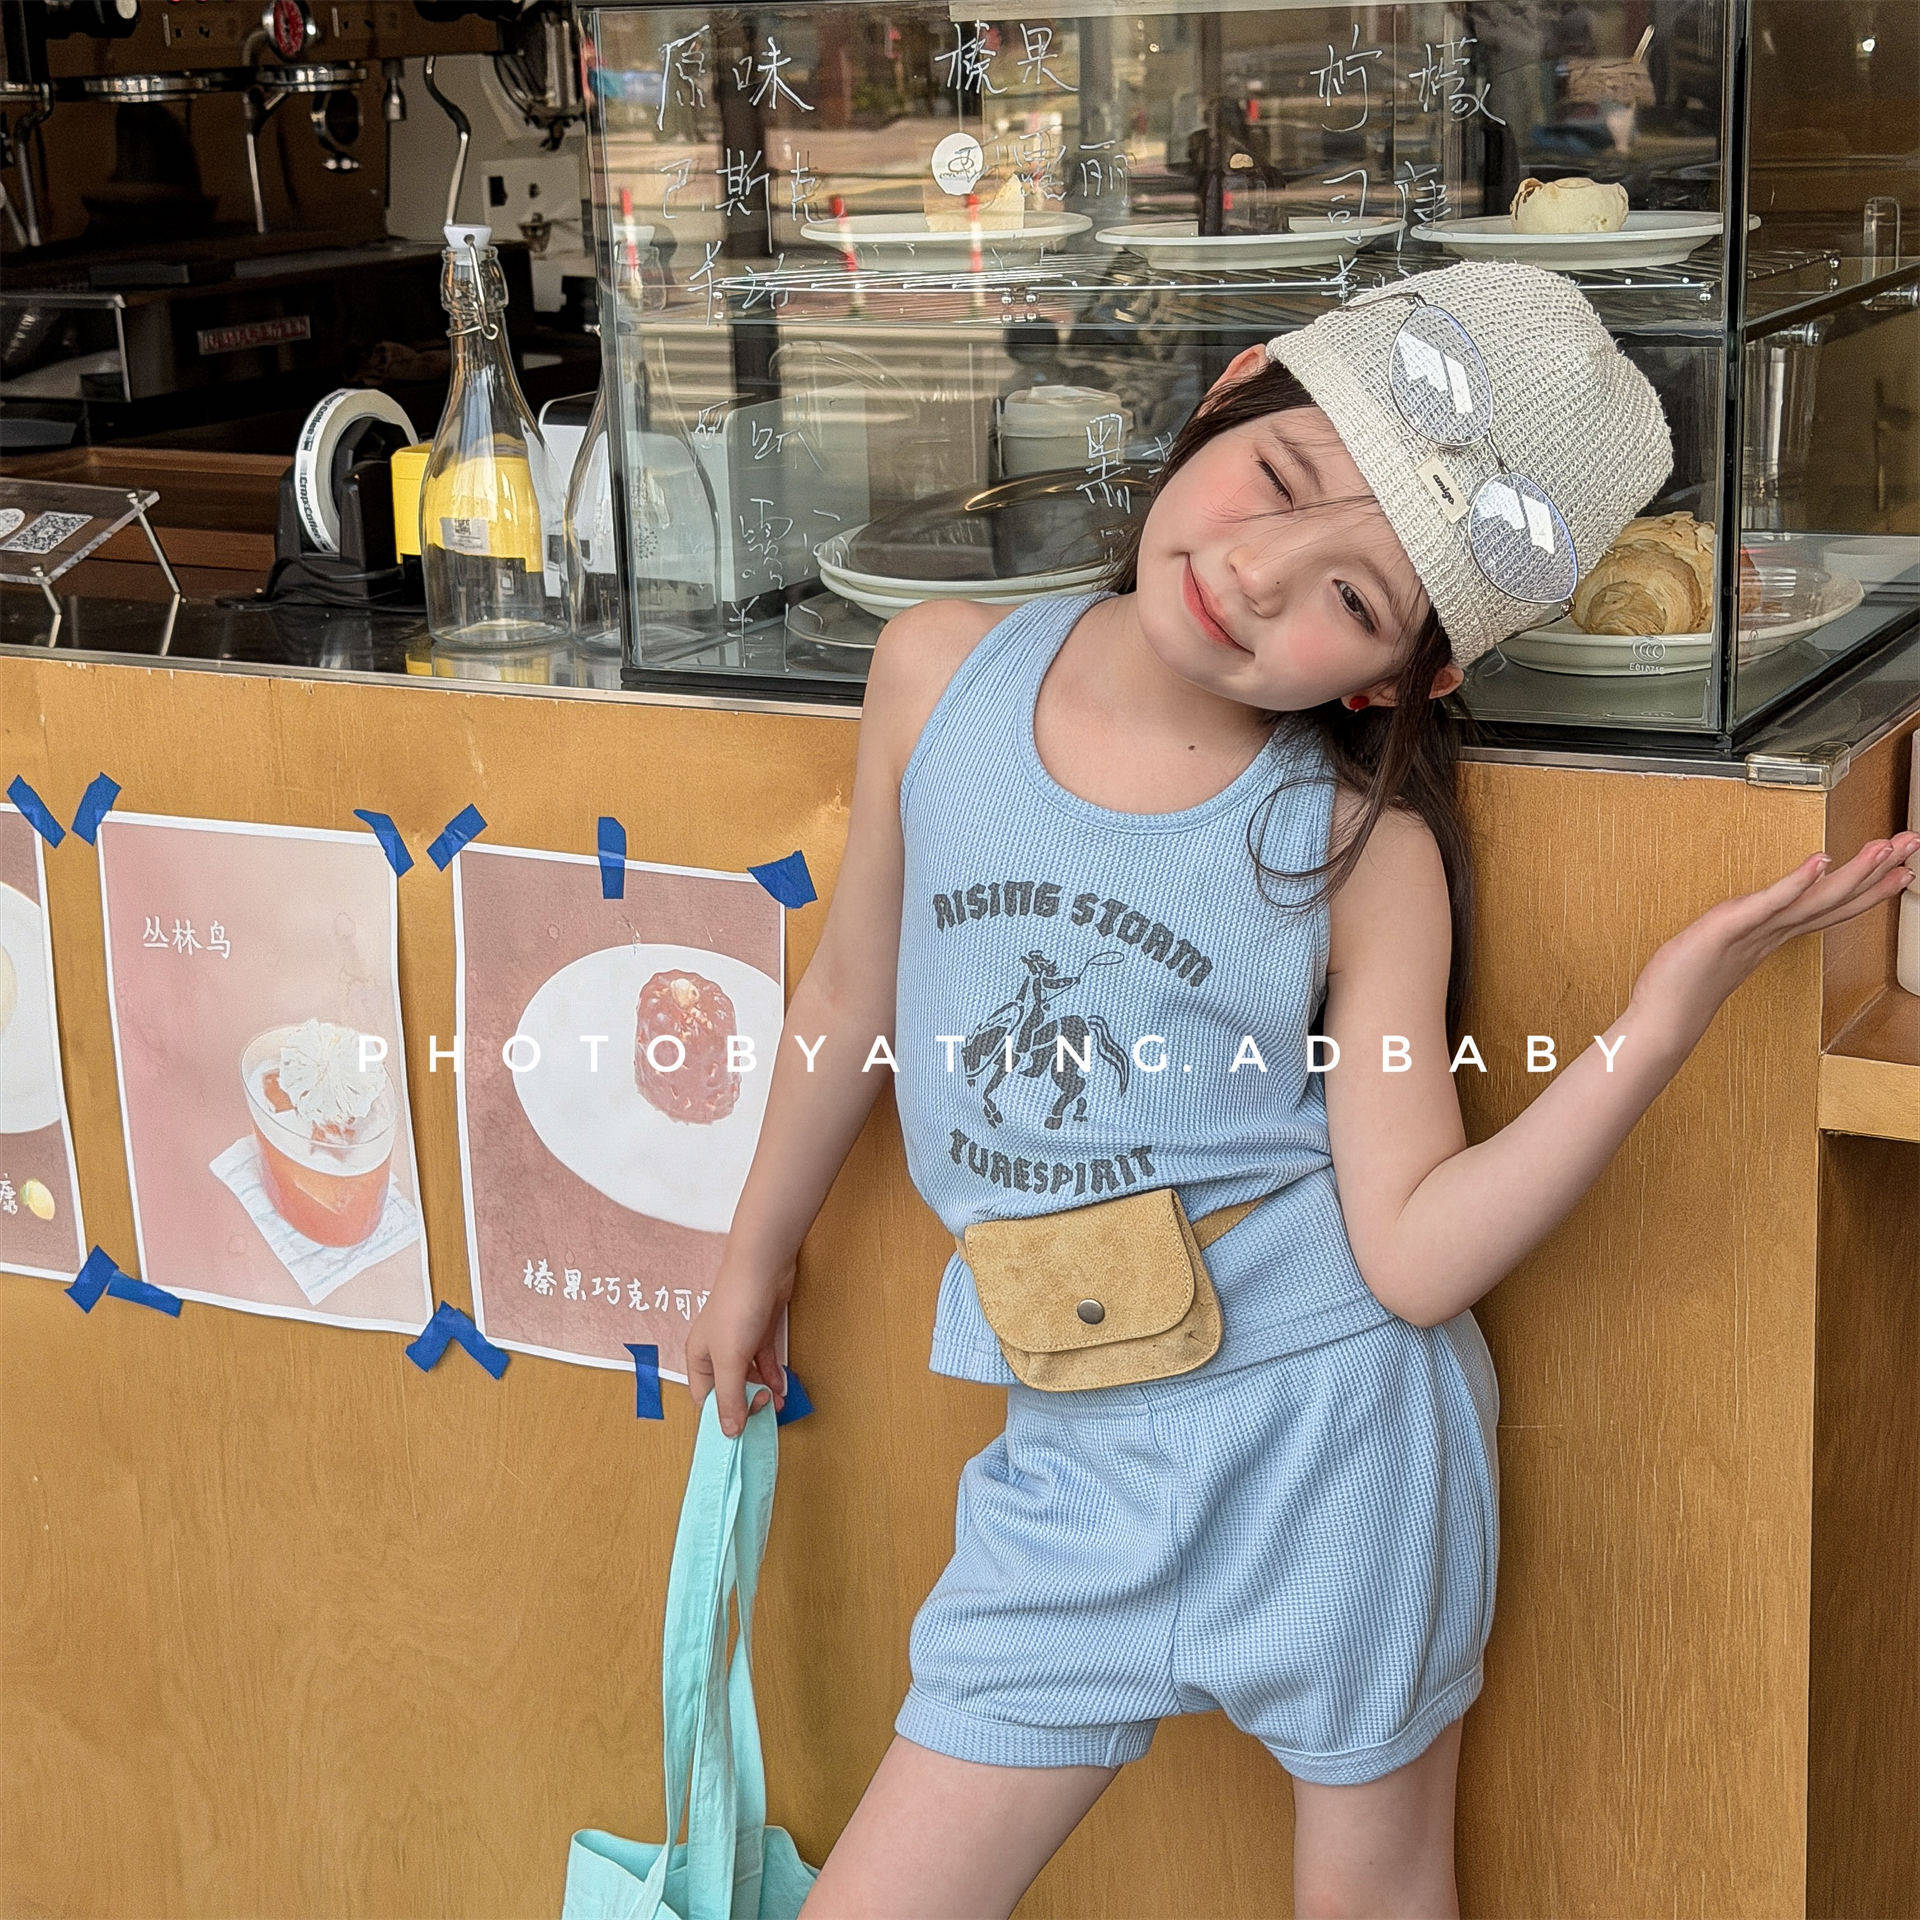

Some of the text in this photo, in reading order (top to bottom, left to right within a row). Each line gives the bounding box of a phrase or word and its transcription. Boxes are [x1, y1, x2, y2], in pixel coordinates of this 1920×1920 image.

[655, 24, 814, 131] 原味
[934, 19, 1080, 95] 榛果
[1310, 24, 1506, 132] 柠檬
[660, 147, 845, 254] 巴斯克
[142, 915, 231, 960] 丛林鸟
[933, 880, 1213, 988] RISING STORM
